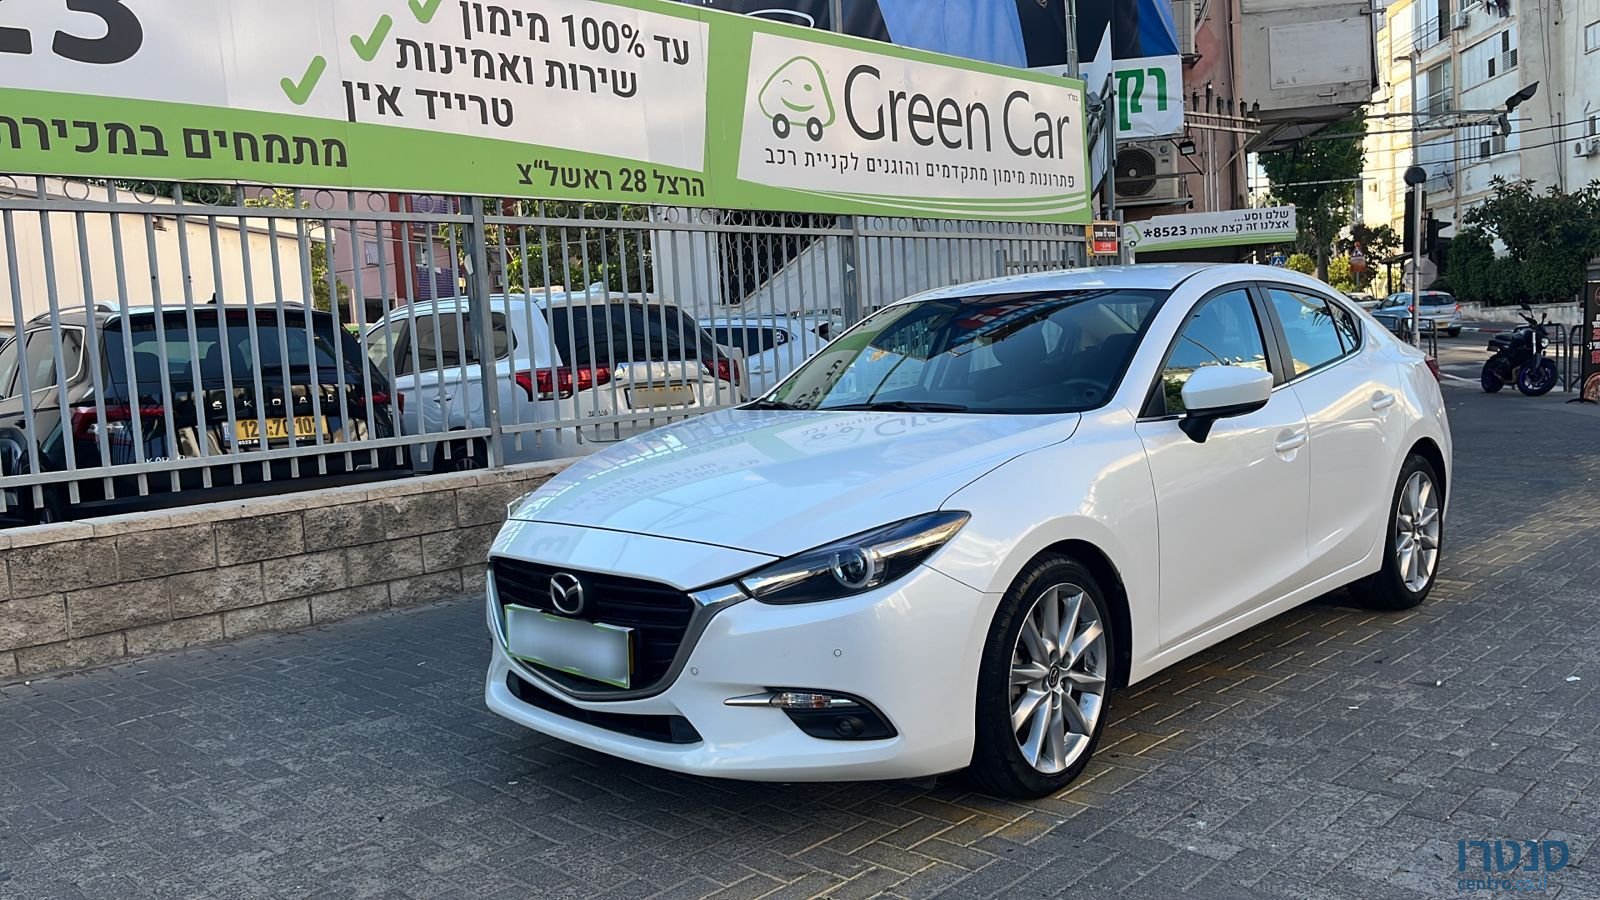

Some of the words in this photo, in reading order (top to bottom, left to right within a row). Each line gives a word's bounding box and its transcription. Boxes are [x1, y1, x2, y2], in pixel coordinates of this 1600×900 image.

[460, 1, 550, 44] מימון
[561, 14, 645, 59] 100%
[396, 37, 534, 85] ואמינות
[653, 34, 690, 66] עד
[545, 59, 637, 98] שירות
[341, 80, 404, 123] אין
[415, 88, 514, 128] טרייד
[1114, 67, 1168, 131] רק
[844, 64, 992, 153] Green
[1003, 90, 1070, 160] Car
[182, 127, 348, 168] מתמחים
[765, 148, 797, 166] רכב
[804, 152, 859, 174] לקניית
[867, 157, 919, 176] והוגנים
[926, 163, 988, 183] מתקדמים
[619, 168, 648, 193] 28
[653, 169, 705, 198] הרצל
[993, 168, 1025, 186] מימון
[1030, 172, 1075, 188] פתרונות
[1246, 222, 1257, 231] זה
[1260, 220, 1289, 230] אצלנו
[1266, 209, 1289, 220] שלם
[1190, 225, 1218, 235] אחרת
[1221, 223, 1242, 234] קצת
